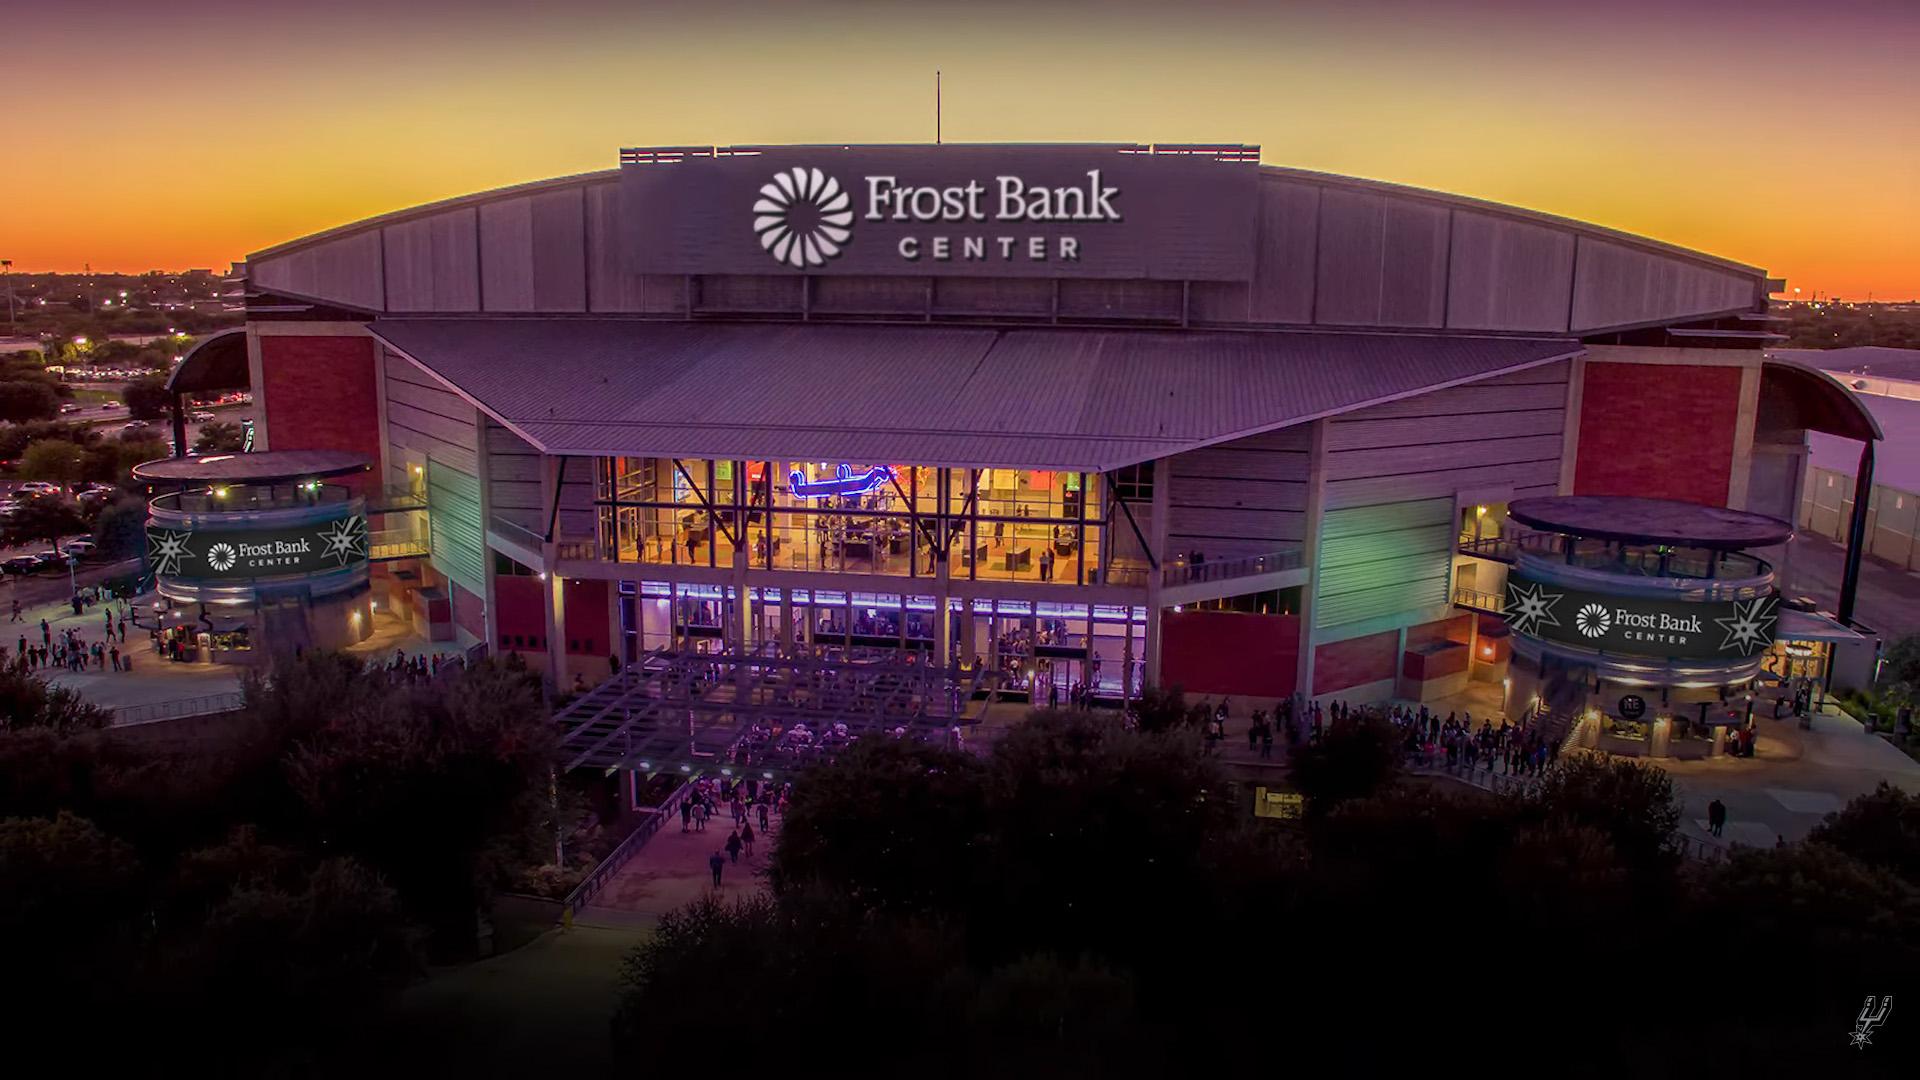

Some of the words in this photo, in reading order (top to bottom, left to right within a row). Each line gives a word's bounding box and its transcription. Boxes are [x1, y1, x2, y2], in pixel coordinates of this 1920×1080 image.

[865, 175, 984, 220] Frost
[996, 169, 1120, 220] Bank
[899, 236, 1080, 259] CENTER
[239, 543, 273, 557] Frost
[275, 538, 311, 554] Bank
[249, 556, 300, 567] CENTER
[1614, 608, 1656, 628] Frost
[1659, 613, 1702, 633] Bank
[1624, 630, 1687, 645] CENTER
